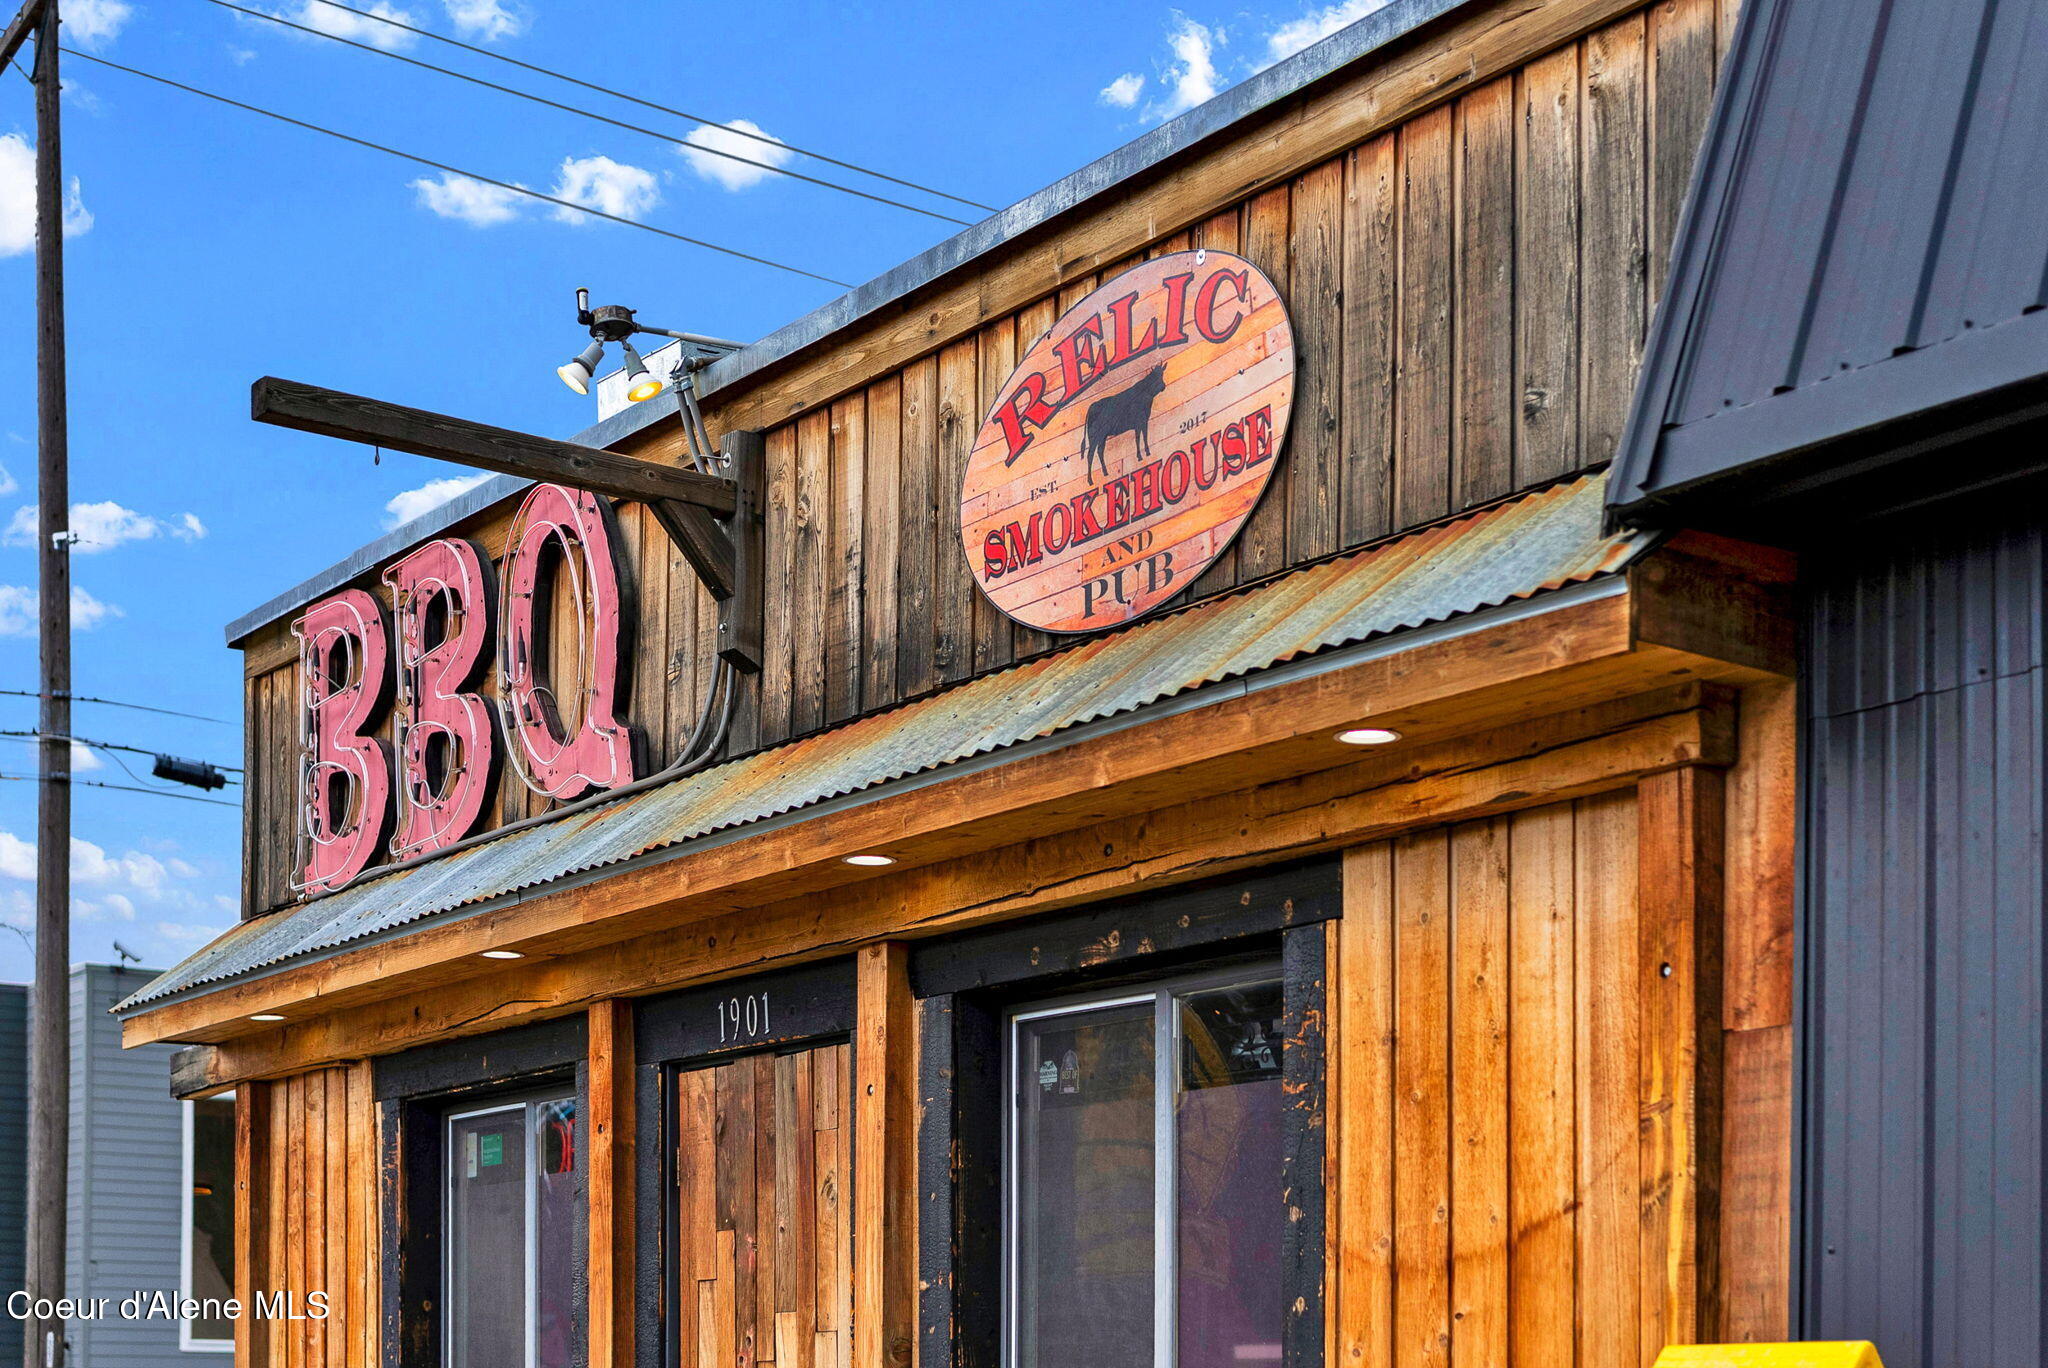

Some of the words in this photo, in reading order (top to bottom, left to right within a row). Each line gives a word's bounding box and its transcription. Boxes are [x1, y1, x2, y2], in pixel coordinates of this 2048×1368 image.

[992, 268, 1249, 468] RELIC
[1179, 410, 1208, 434] 2017
[984, 404, 1272, 583] SMOKEHOUSE
[1101, 530, 1154, 567] AND
[1081, 551, 1174, 620] PUB
[290, 483, 634, 897] BBQ
[718, 991, 770, 1043] 1901
